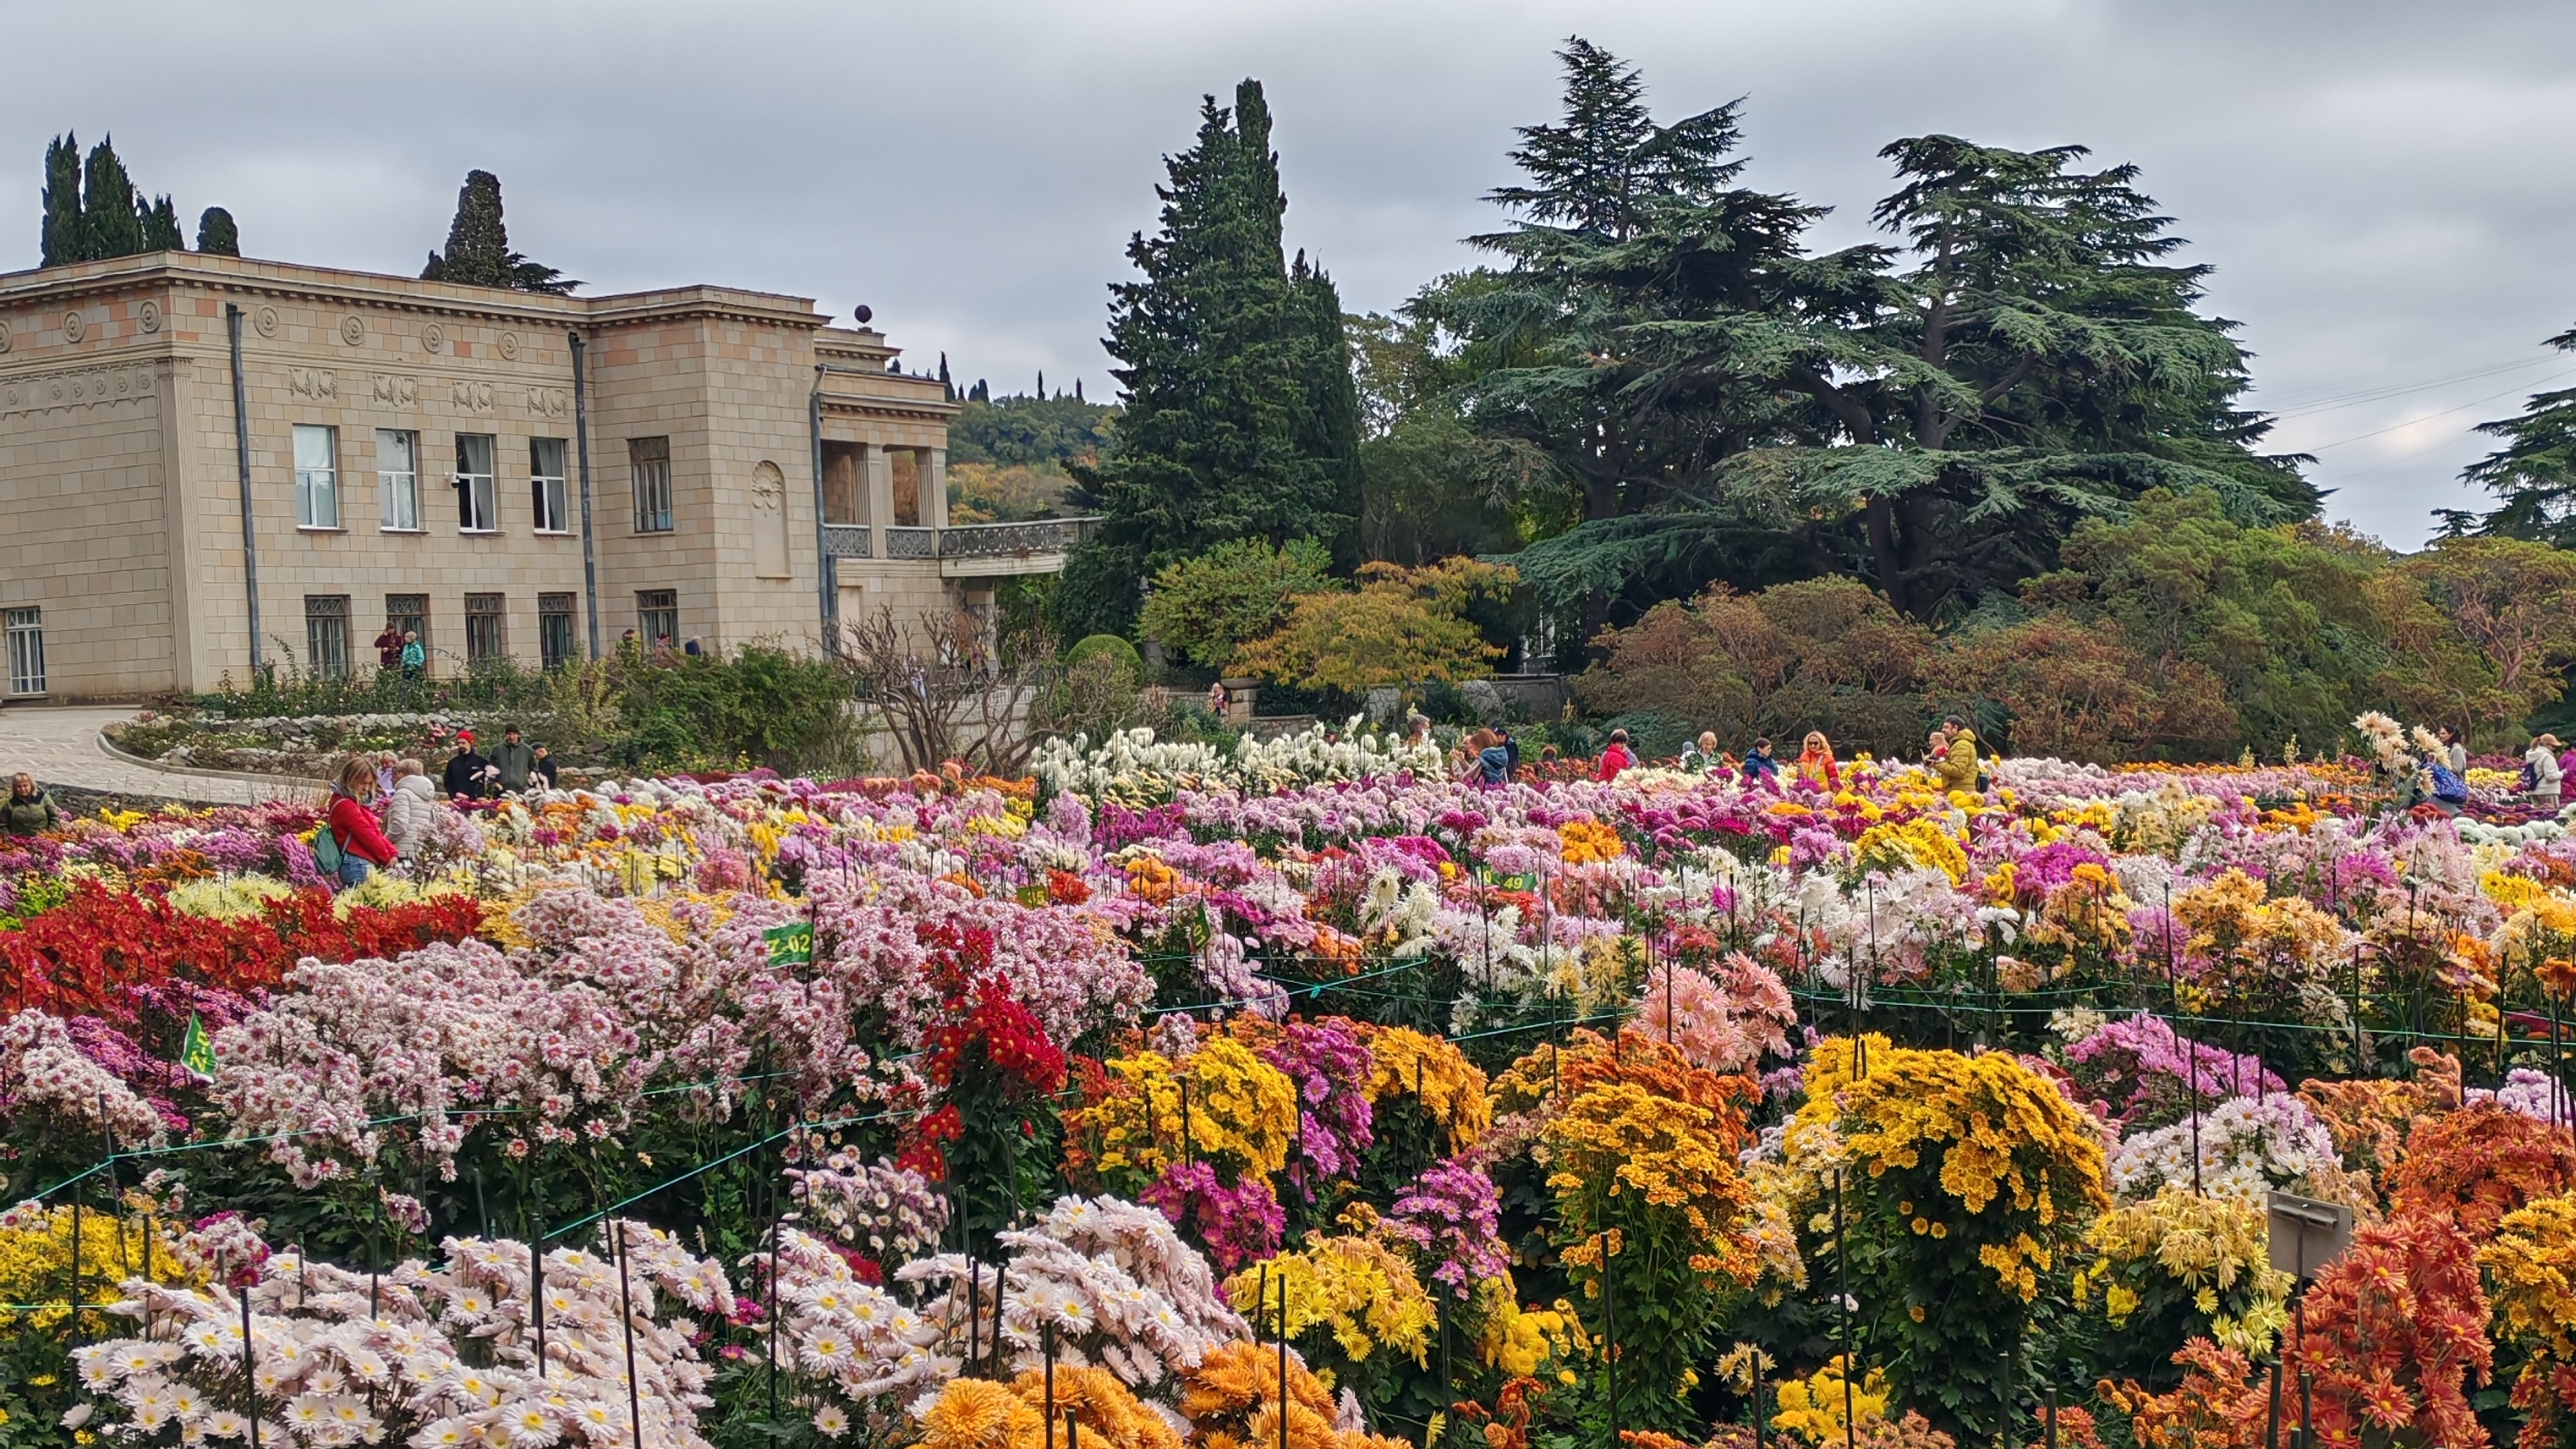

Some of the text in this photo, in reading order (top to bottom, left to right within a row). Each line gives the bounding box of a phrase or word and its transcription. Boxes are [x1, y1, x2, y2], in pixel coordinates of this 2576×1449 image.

[1504, 877, 1523, 890] 49
[765, 934, 810, 958] Z-02
[1193, 925, 1206, 946] 01
